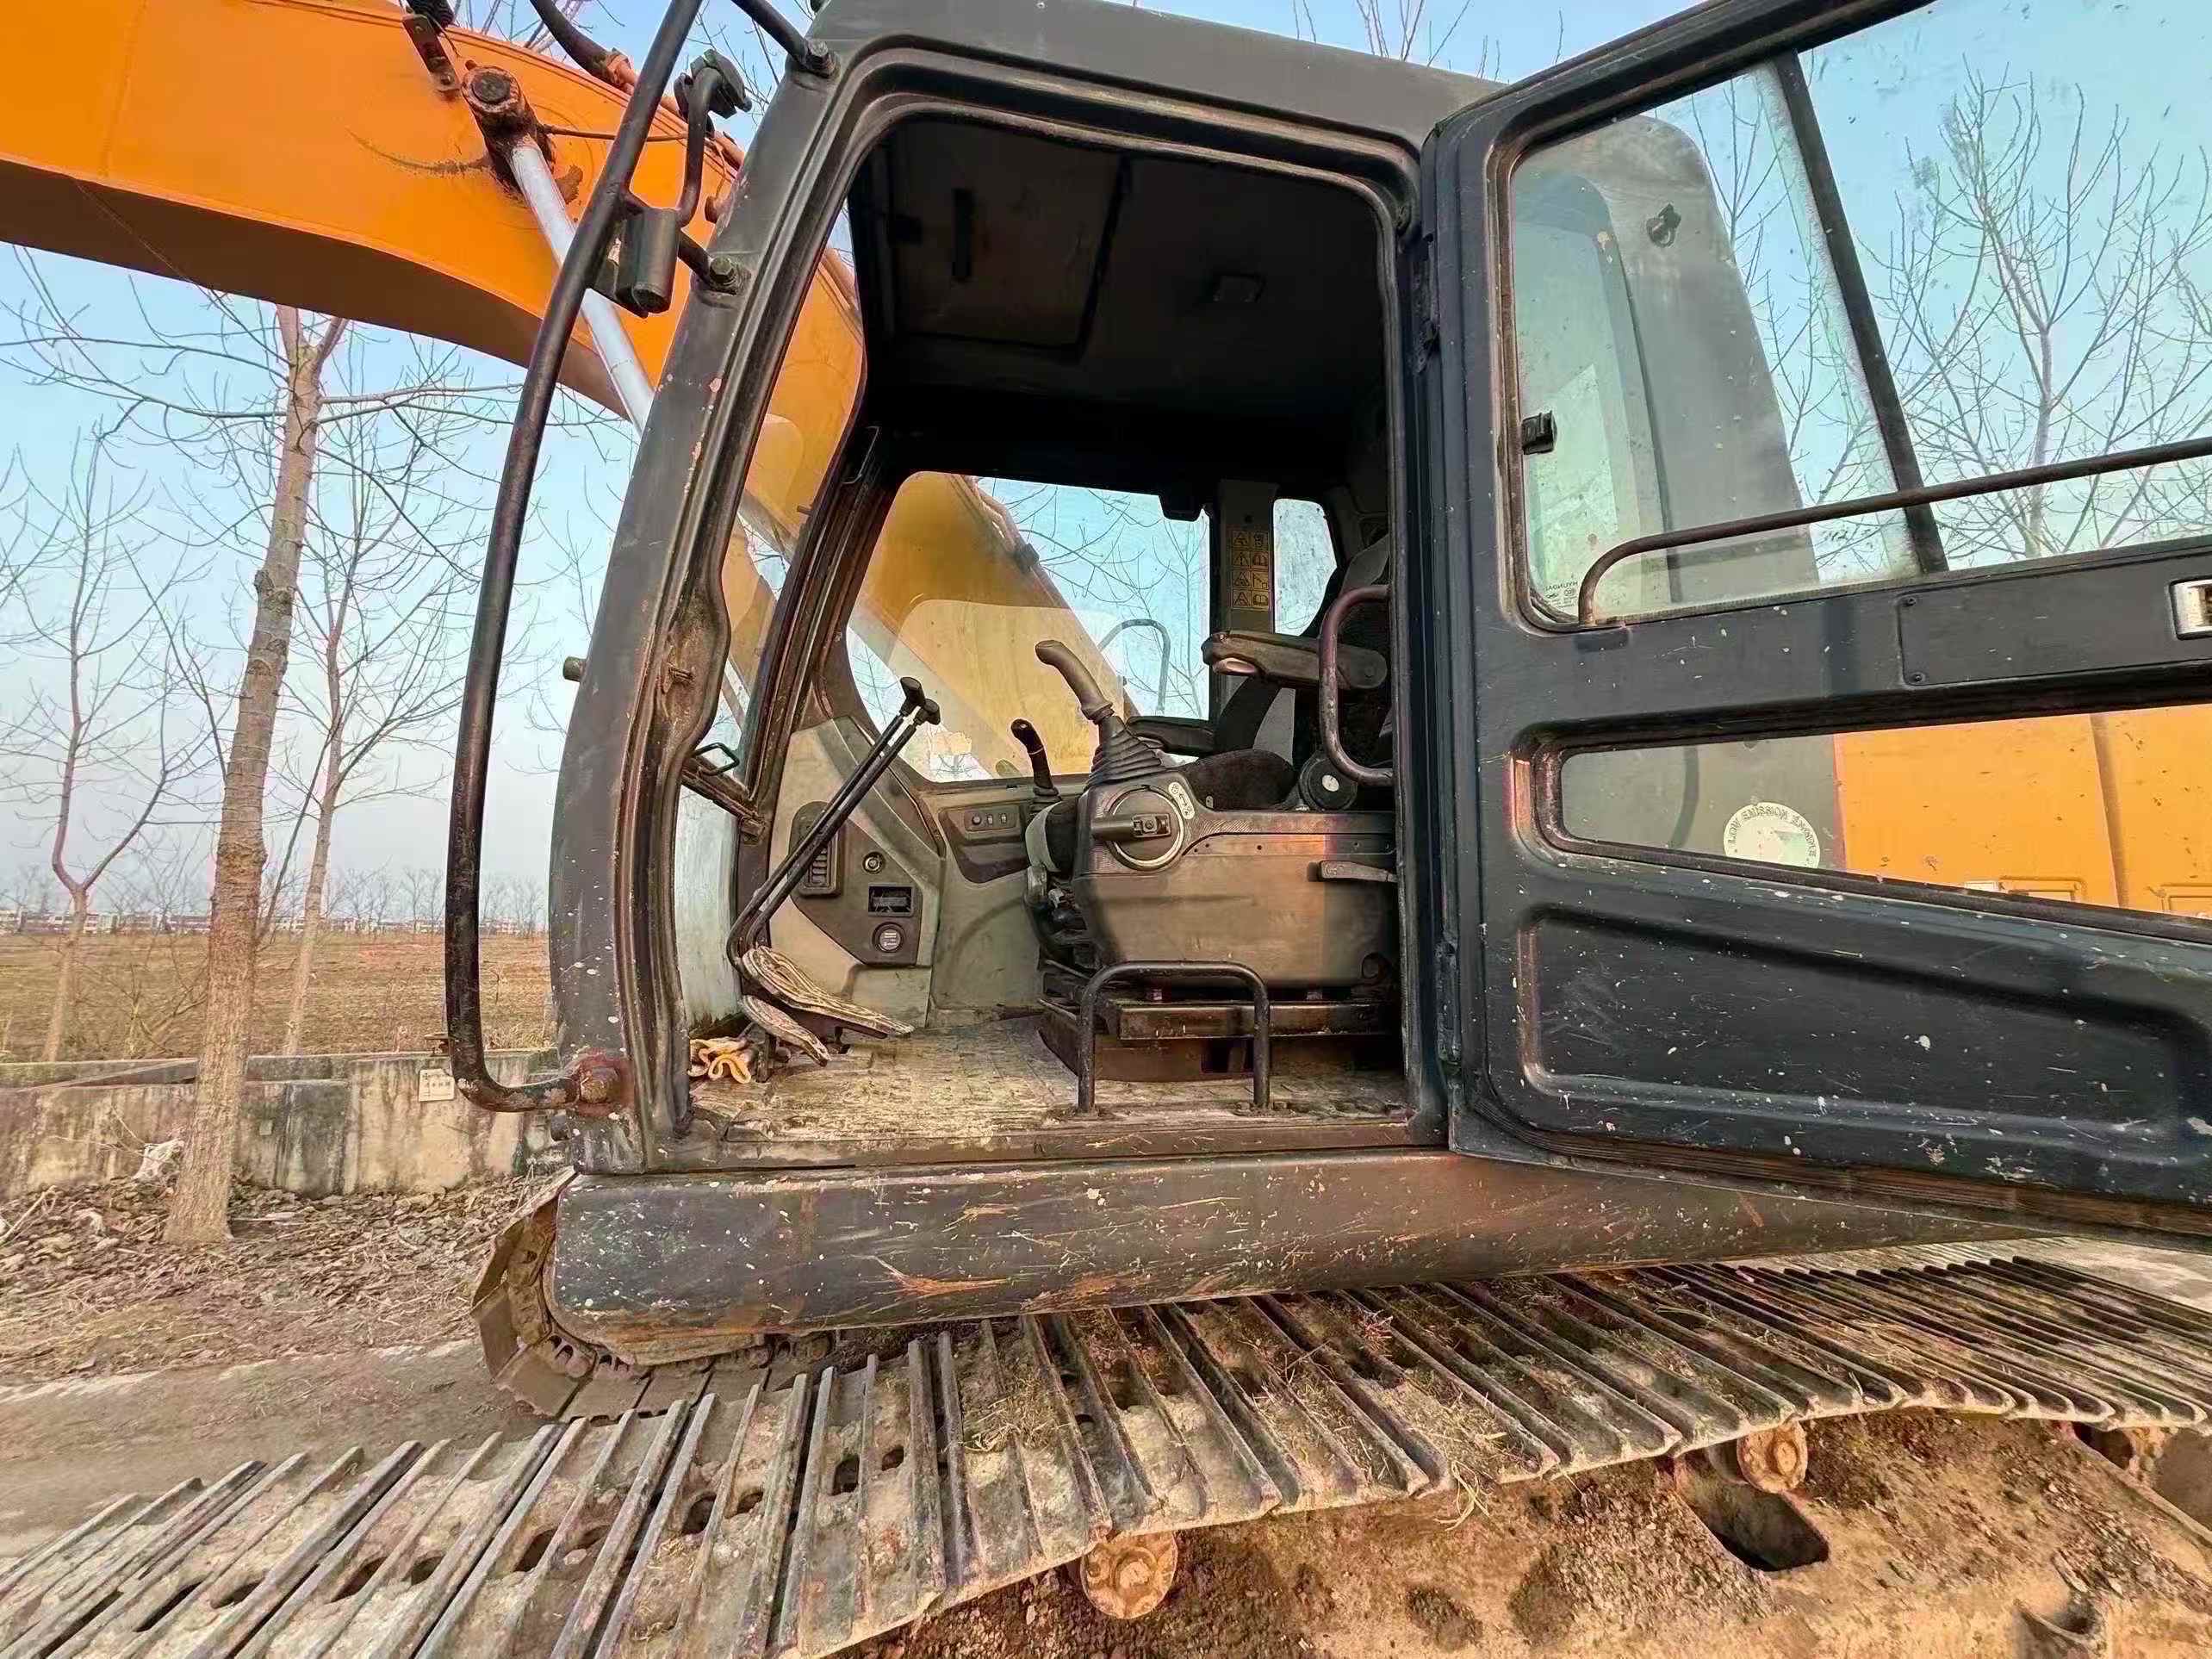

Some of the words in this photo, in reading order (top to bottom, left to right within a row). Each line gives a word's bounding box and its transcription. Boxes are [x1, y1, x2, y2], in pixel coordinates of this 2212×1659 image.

[1727, 817, 1742, 844] LOW
[1741, 805, 1788, 820] EMISSION
[1792, 814, 1817, 857] ENGINE
